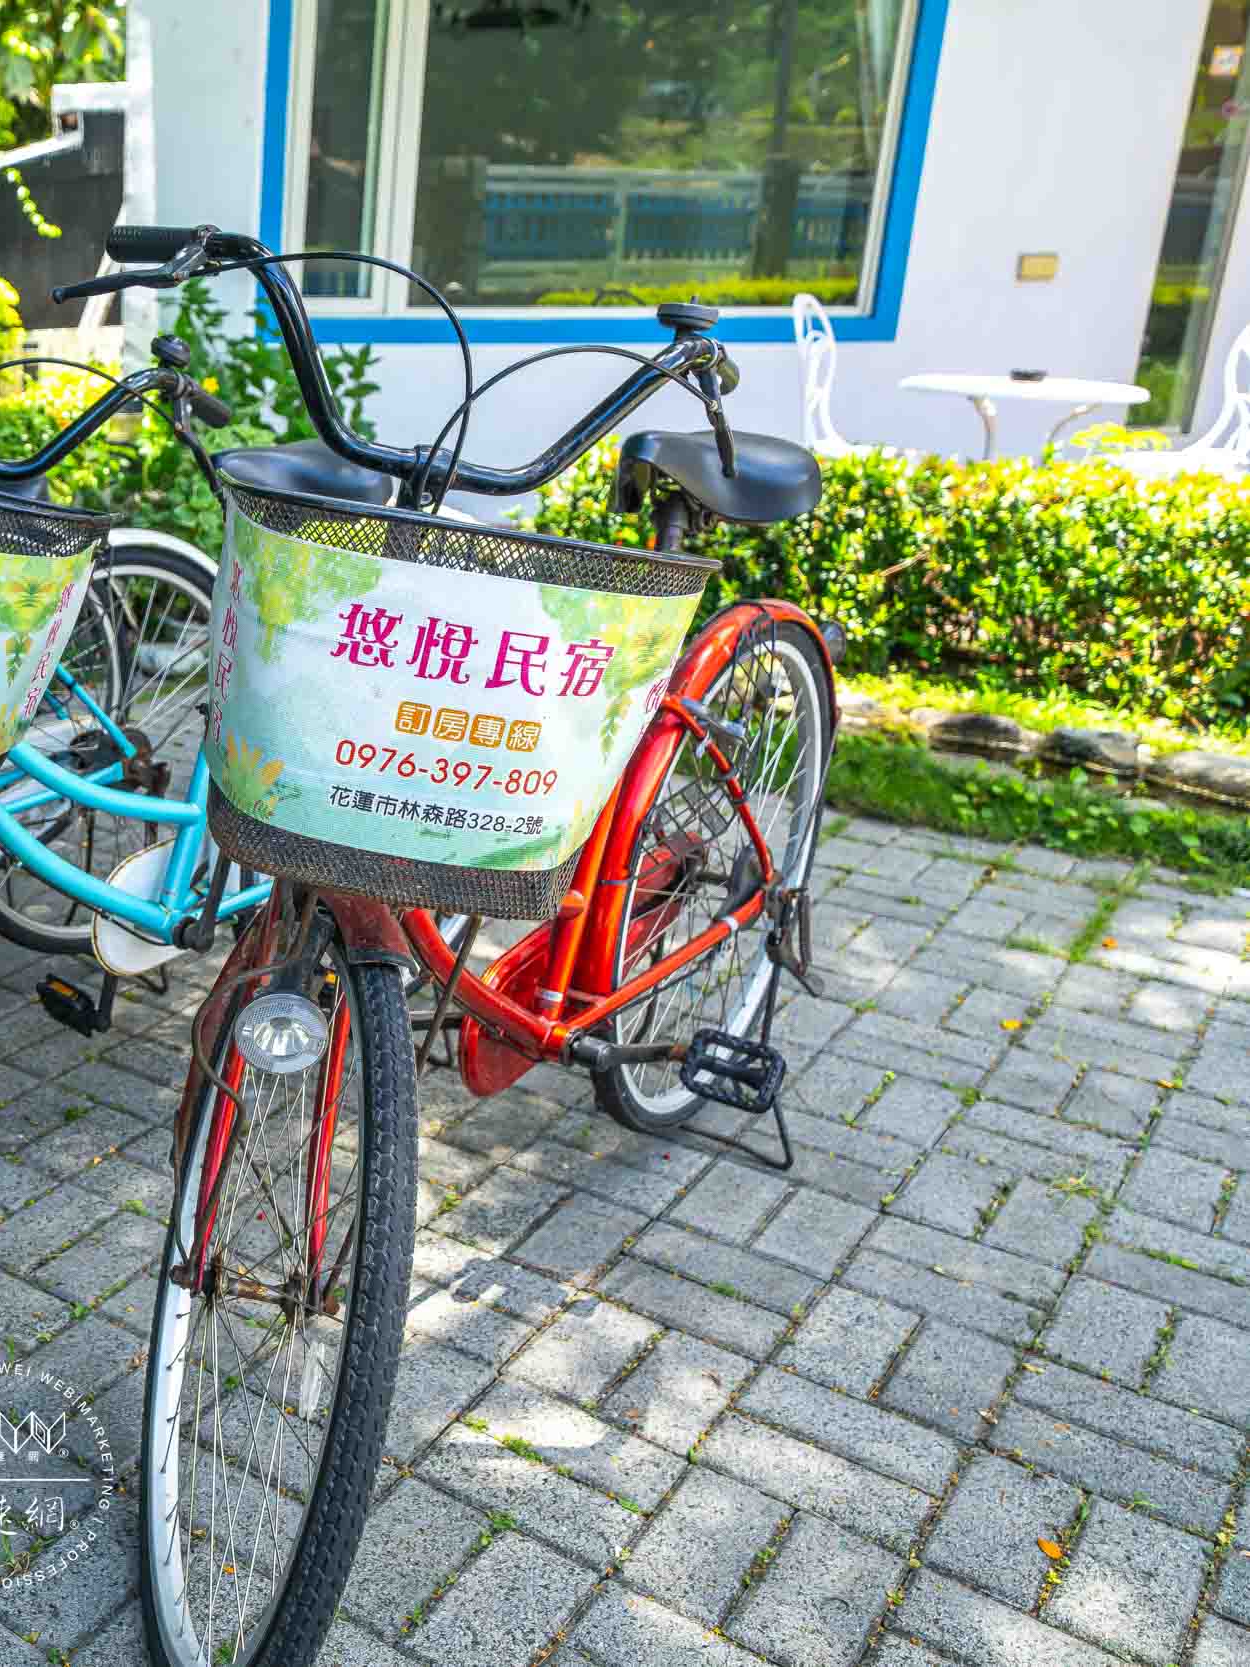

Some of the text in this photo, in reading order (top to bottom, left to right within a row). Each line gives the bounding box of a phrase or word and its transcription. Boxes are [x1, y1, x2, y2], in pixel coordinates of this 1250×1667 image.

[330, 602, 616, 698] 悠悅民宿
[395, 700, 544, 753] 訂房專線
[335, 739, 559, 797] 0976-397-809
[329, 783, 544, 836] 花蓮市林森路328-2號
